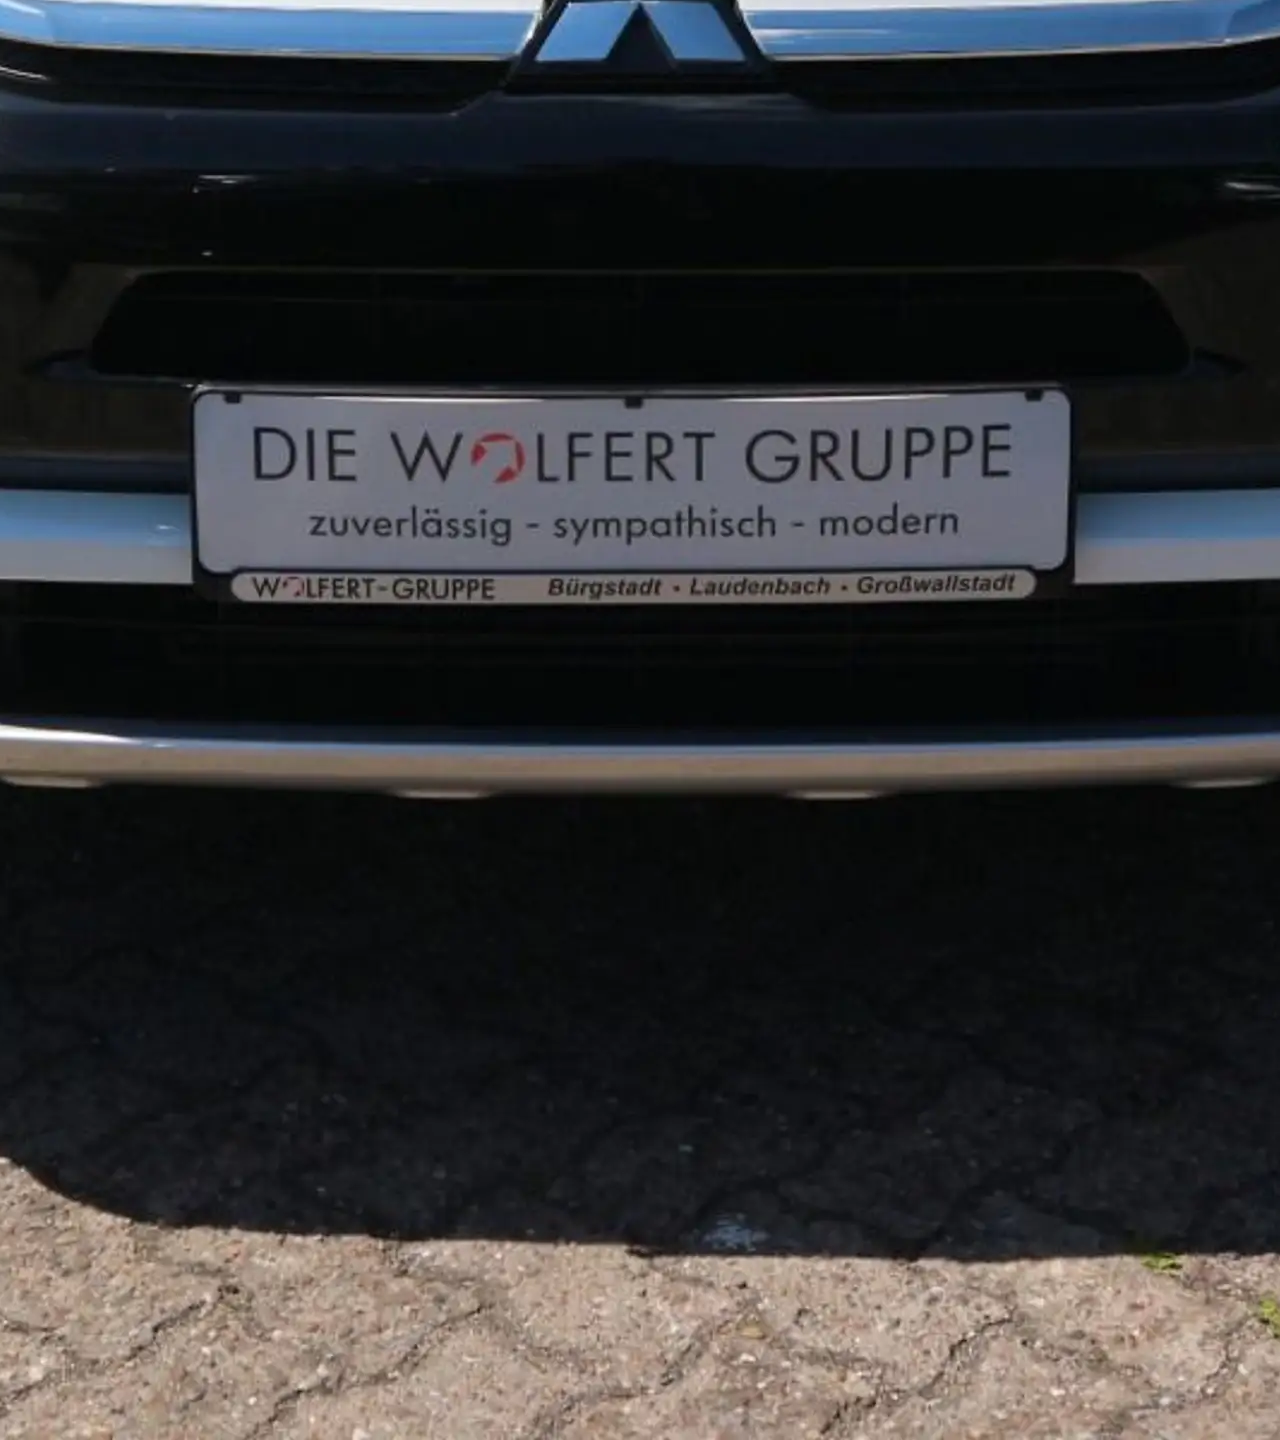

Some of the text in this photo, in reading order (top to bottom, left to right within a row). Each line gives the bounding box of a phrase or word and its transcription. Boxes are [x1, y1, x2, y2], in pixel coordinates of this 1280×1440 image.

[252, 426, 358, 482] DIE
[745, 423, 1012, 484] GRUPPE
[308, 505, 512, 546] zuverlässig
[553, 504, 777, 546] sympathisch
[819, 503, 960, 537] modern
[547, 572, 1017, 599] Bürgstadt Laudenbach Großwallstadt
